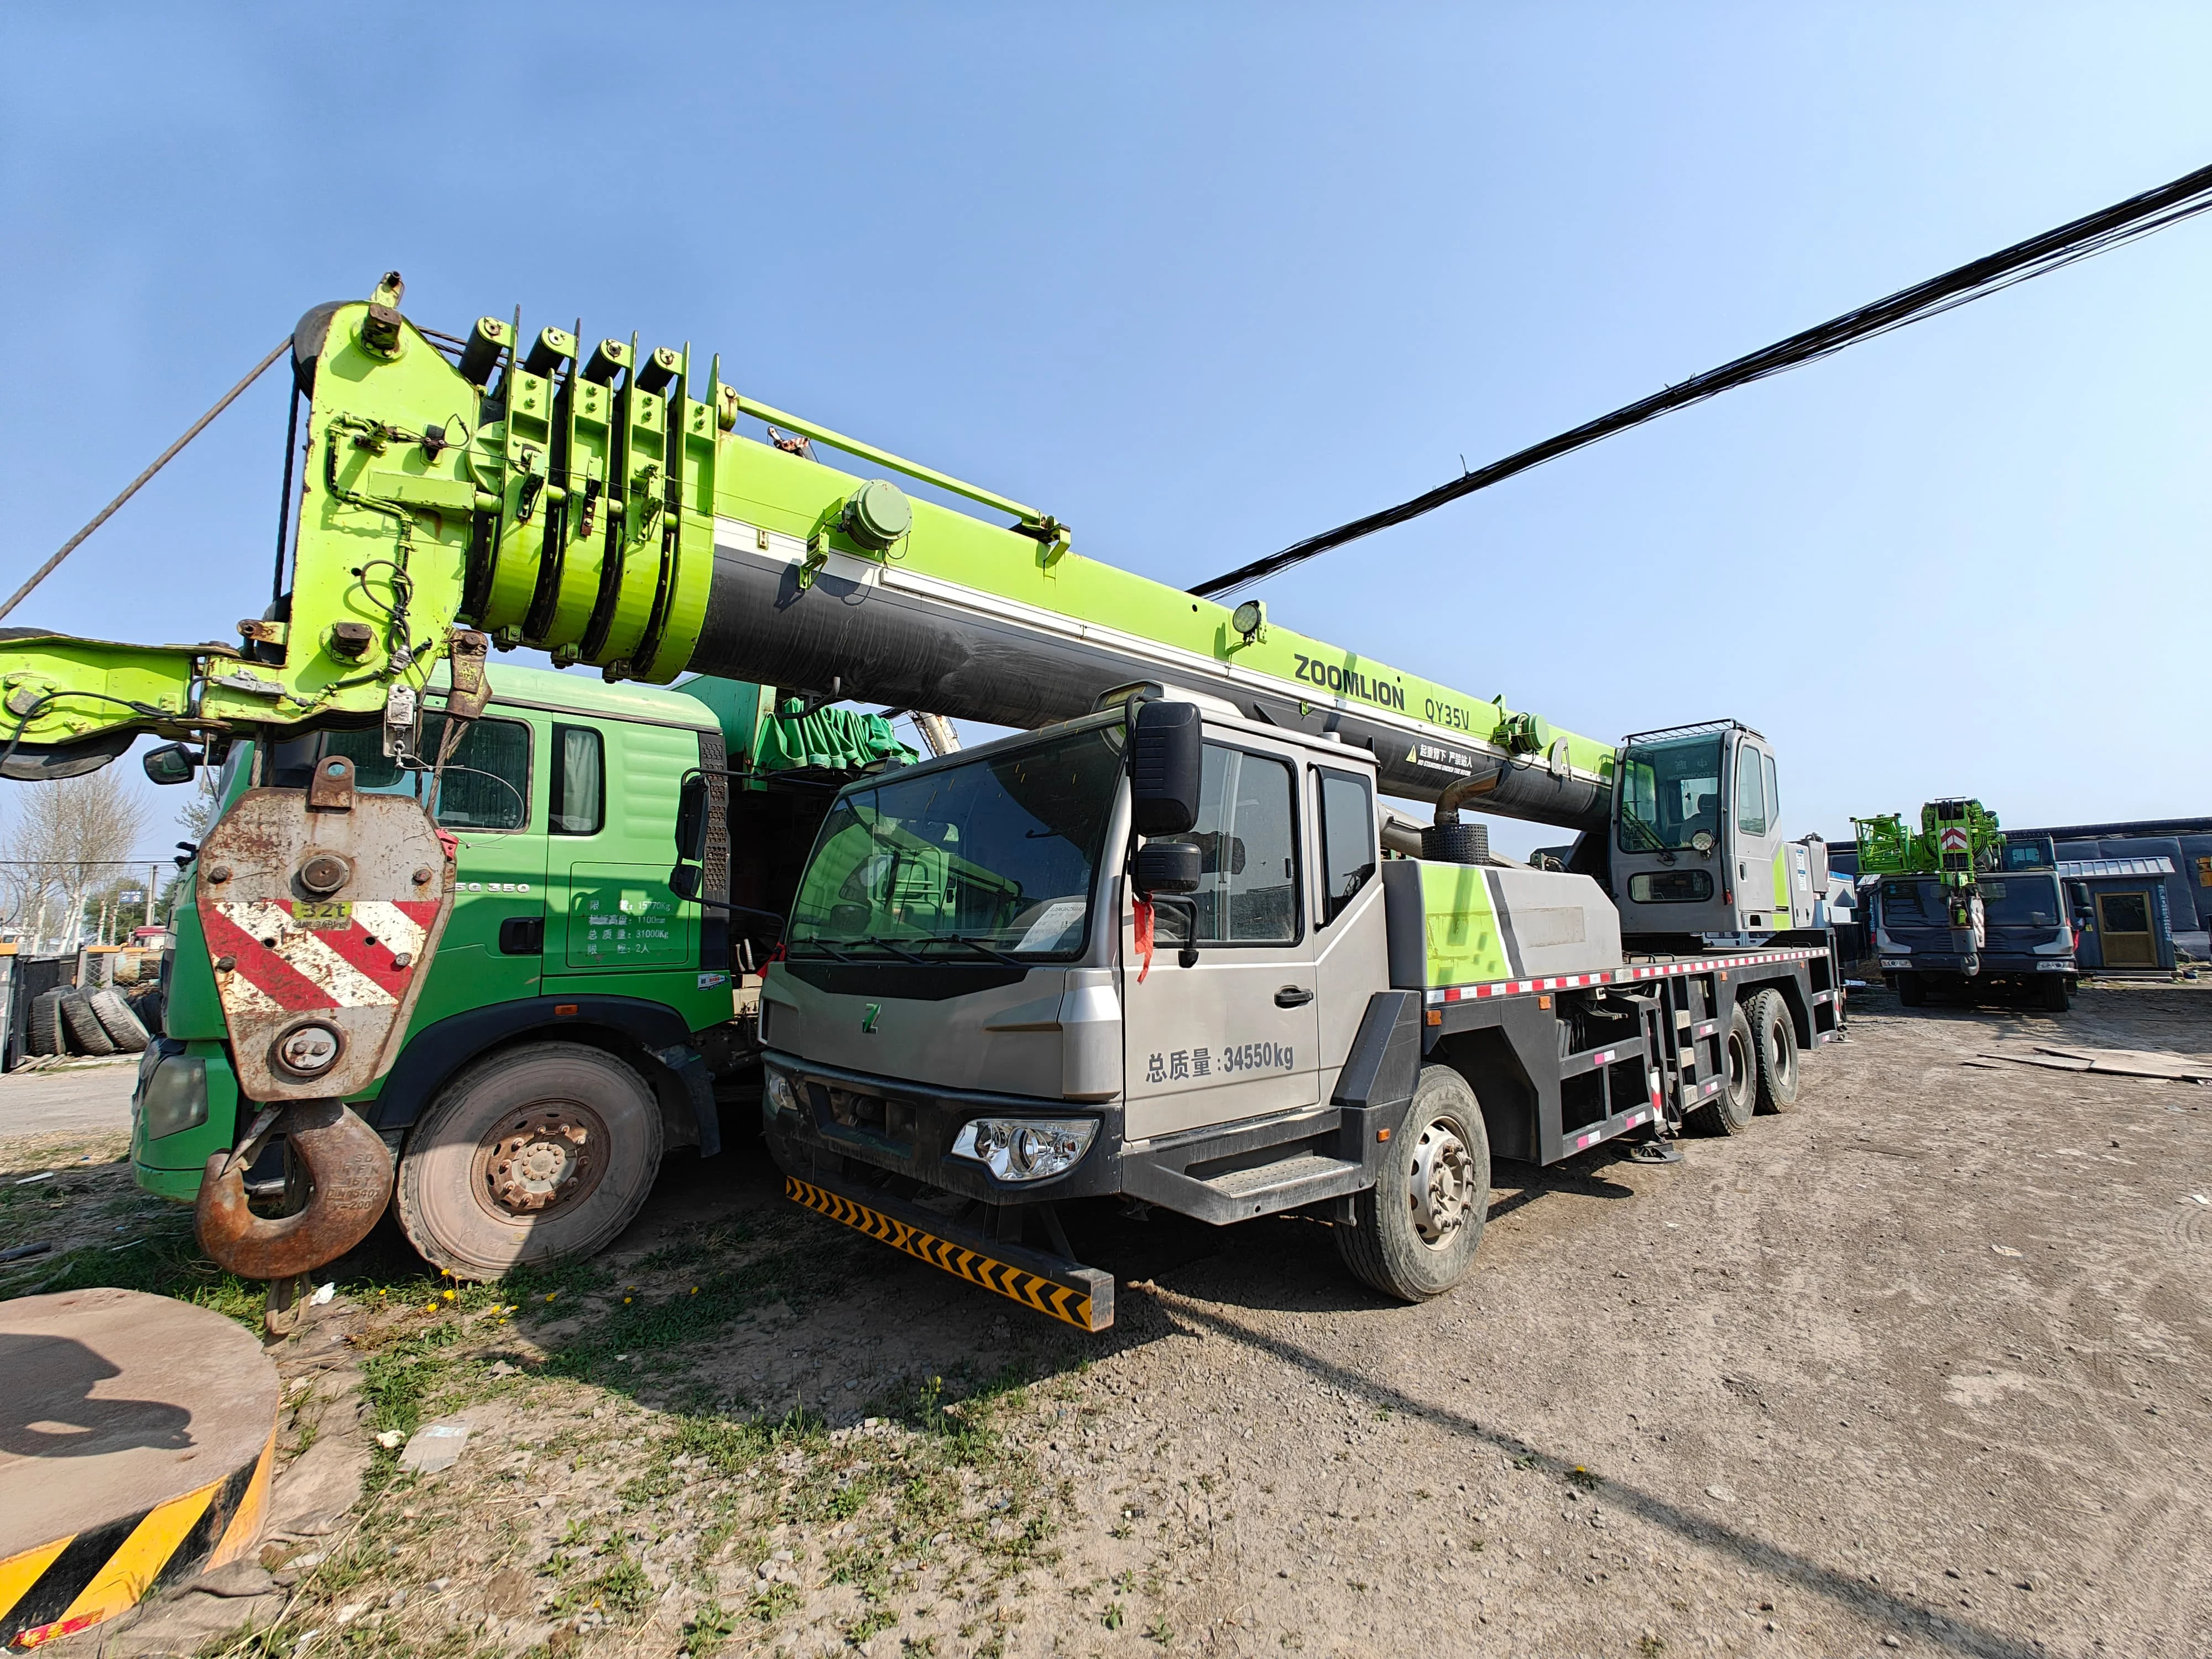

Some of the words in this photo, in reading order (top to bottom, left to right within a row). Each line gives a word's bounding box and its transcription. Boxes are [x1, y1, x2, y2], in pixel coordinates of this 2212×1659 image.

[1294, 654, 1405, 711] ZOOMLION
[1425, 698, 1469, 730] QY35V
[488, 883, 530, 893] 350
